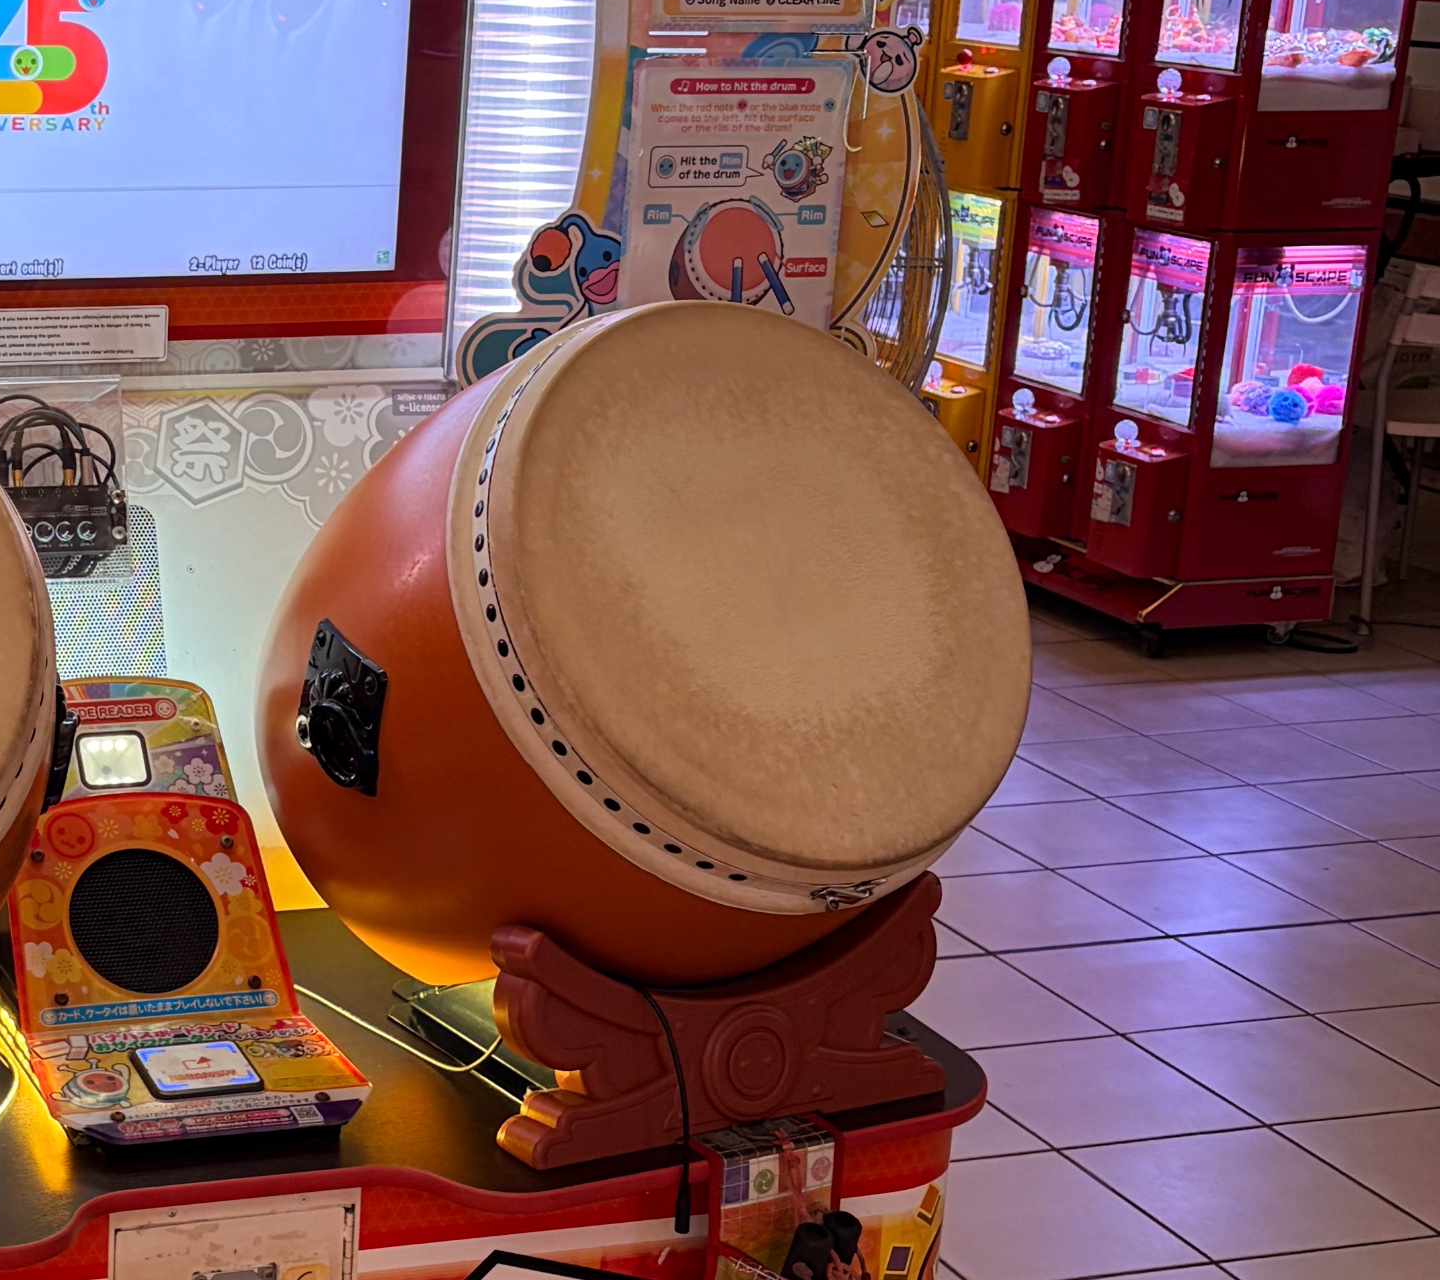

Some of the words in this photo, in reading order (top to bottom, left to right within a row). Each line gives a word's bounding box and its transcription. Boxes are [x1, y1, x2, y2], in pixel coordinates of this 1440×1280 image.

[696, 82, 717, 92] How
[720, 82, 731, 92] to
[734, 81, 747, 91] hit
[751, 81, 767, 91] the
[770, 81, 796, 91] drum
[90, 102, 110, 115] th
[681, 156, 696, 166] Hit
[700, 156, 717, 166] the
[722, 157, 741, 166] Rim
[679, 170, 690, 179] of
[693, 170, 710, 179] the
[713, 170, 740, 179] drum
[647, 209, 669, 221] Rim
[802, 209, 823, 221] Rim
[189, 256, 240, 275] 2-Player
[251, 256, 264, 269] 12
[268, 253, 307, 271] Coin(s)
[787, 262, 826, 273] Surface
[1243, 272, 1276, 283] FUN
[1295, 271, 1347, 282] SCAPE
[172, 415, 231, 484] 祭
[99, 704, 152, 719] READER
